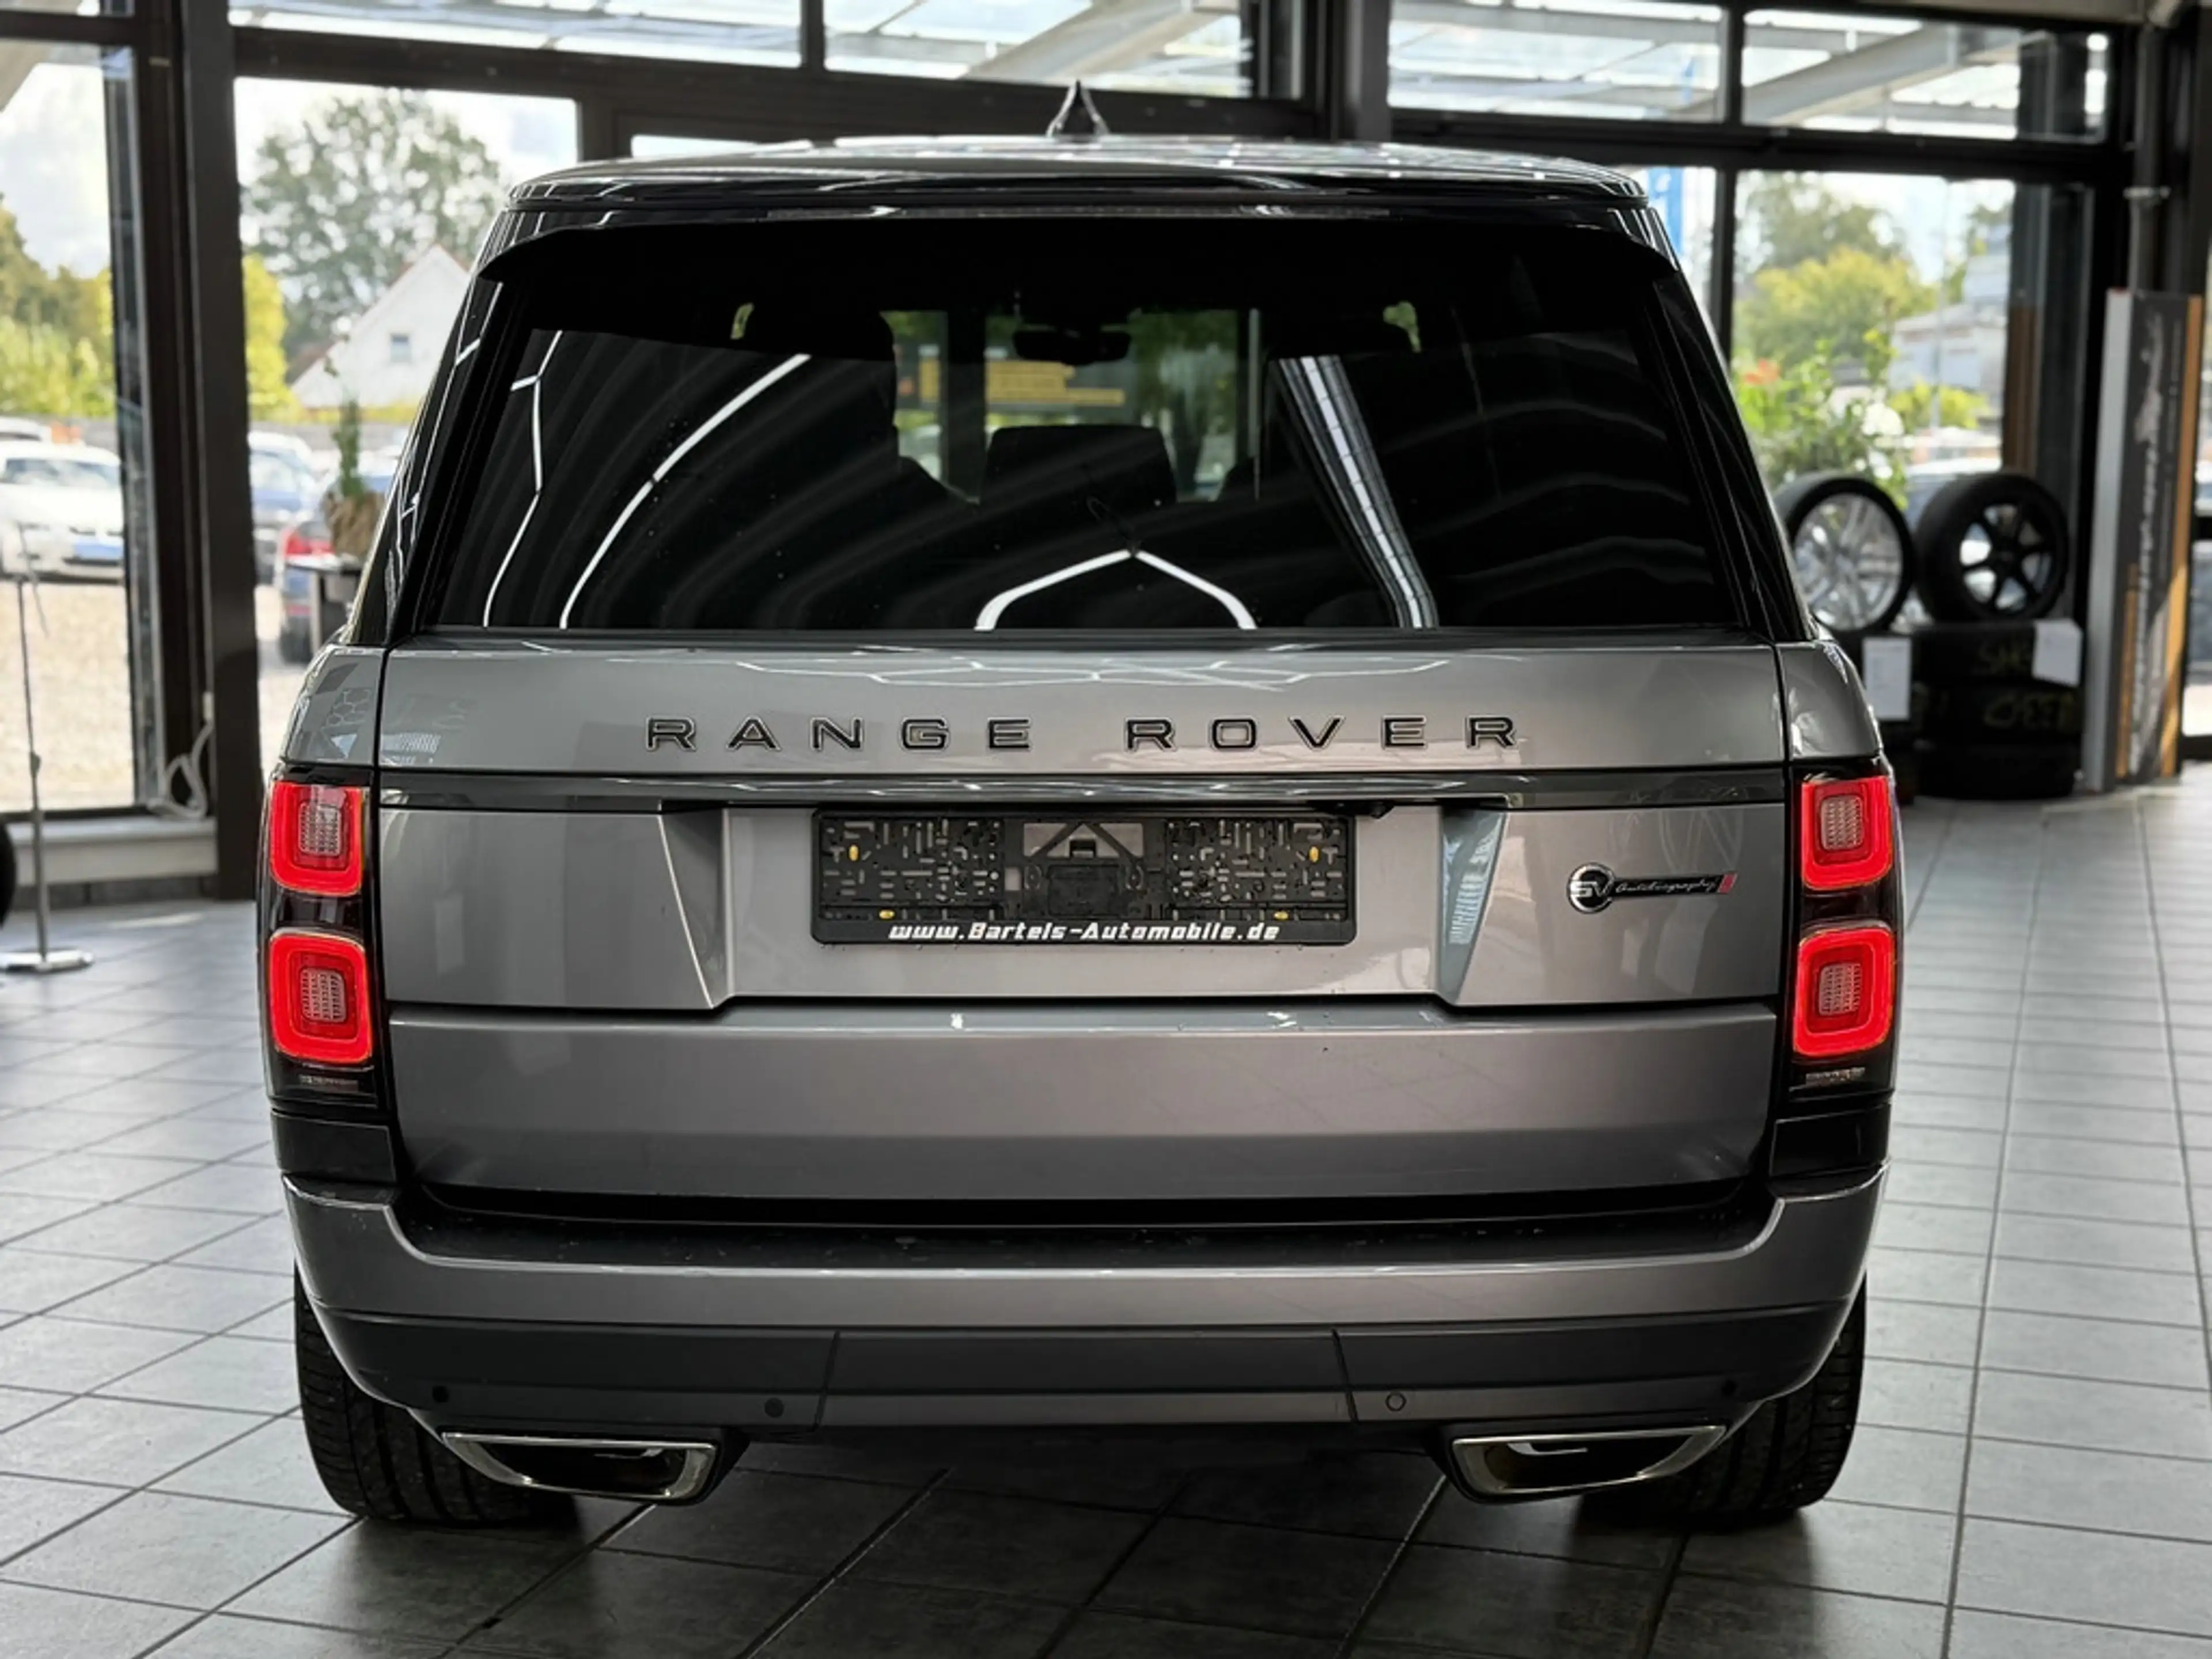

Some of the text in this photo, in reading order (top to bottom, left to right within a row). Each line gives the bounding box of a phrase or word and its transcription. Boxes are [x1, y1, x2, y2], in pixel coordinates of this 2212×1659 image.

[646, 715, 1519, 752] RANGE ROVER
[888, 922, 1280, 942] www.Bartels-Automobile.de
